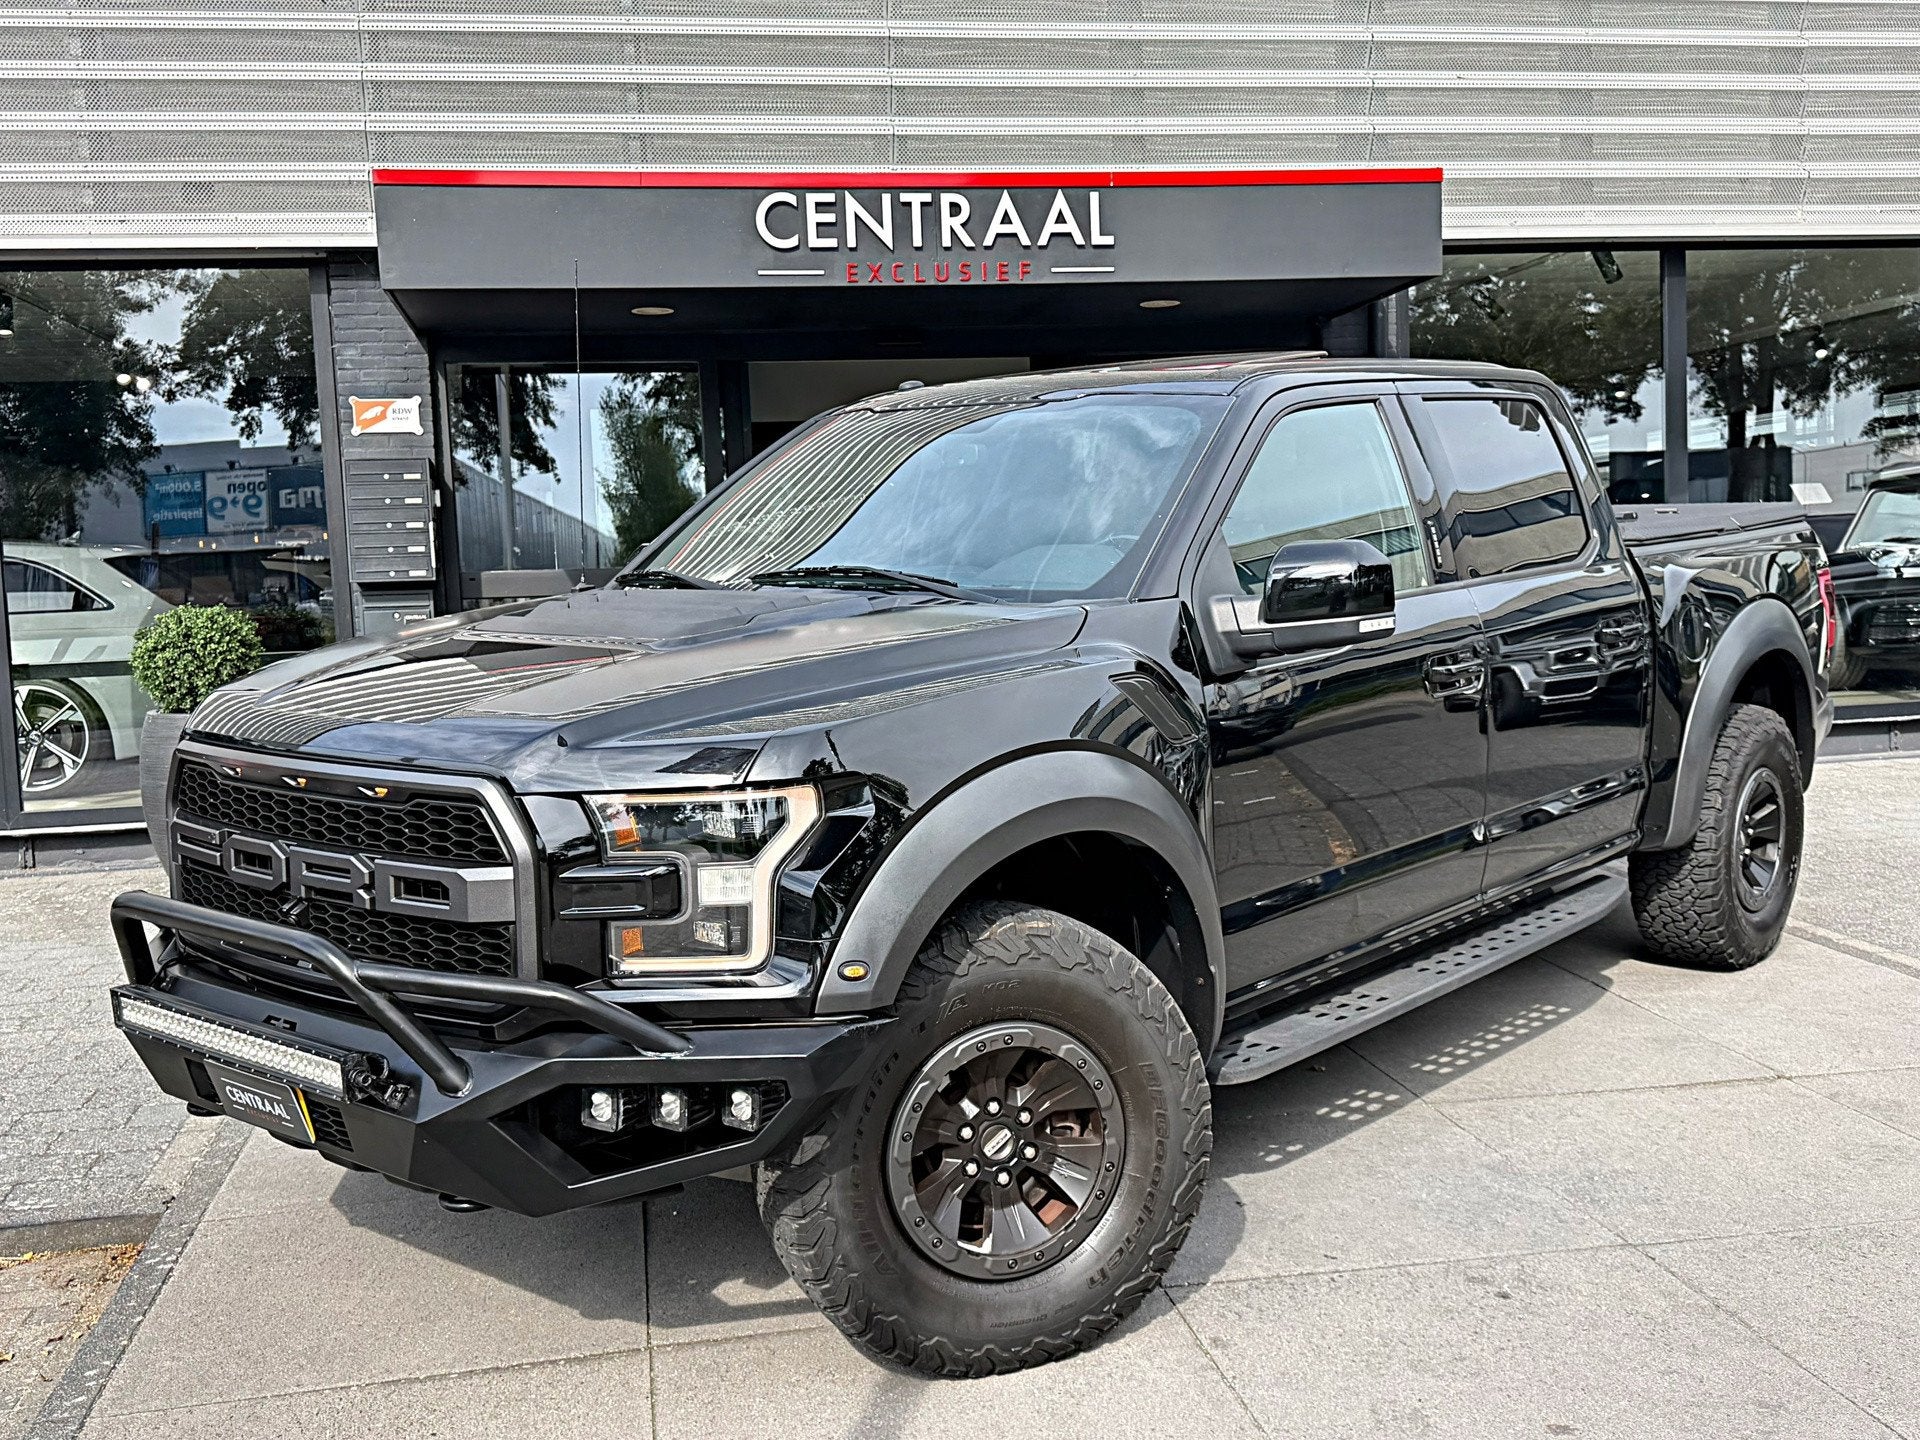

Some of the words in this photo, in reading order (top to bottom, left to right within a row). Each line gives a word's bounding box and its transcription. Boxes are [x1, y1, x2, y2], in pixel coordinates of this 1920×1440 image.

[755, 188, 1115, 251] CENTRAAL
[846, 261, 1032, 284] EXCLUSIEF
[392, 407, 413, 415] RDW
[171, 818, 475, 922] FORD
[226, 1085, 291, 1120] CENTRAAL
